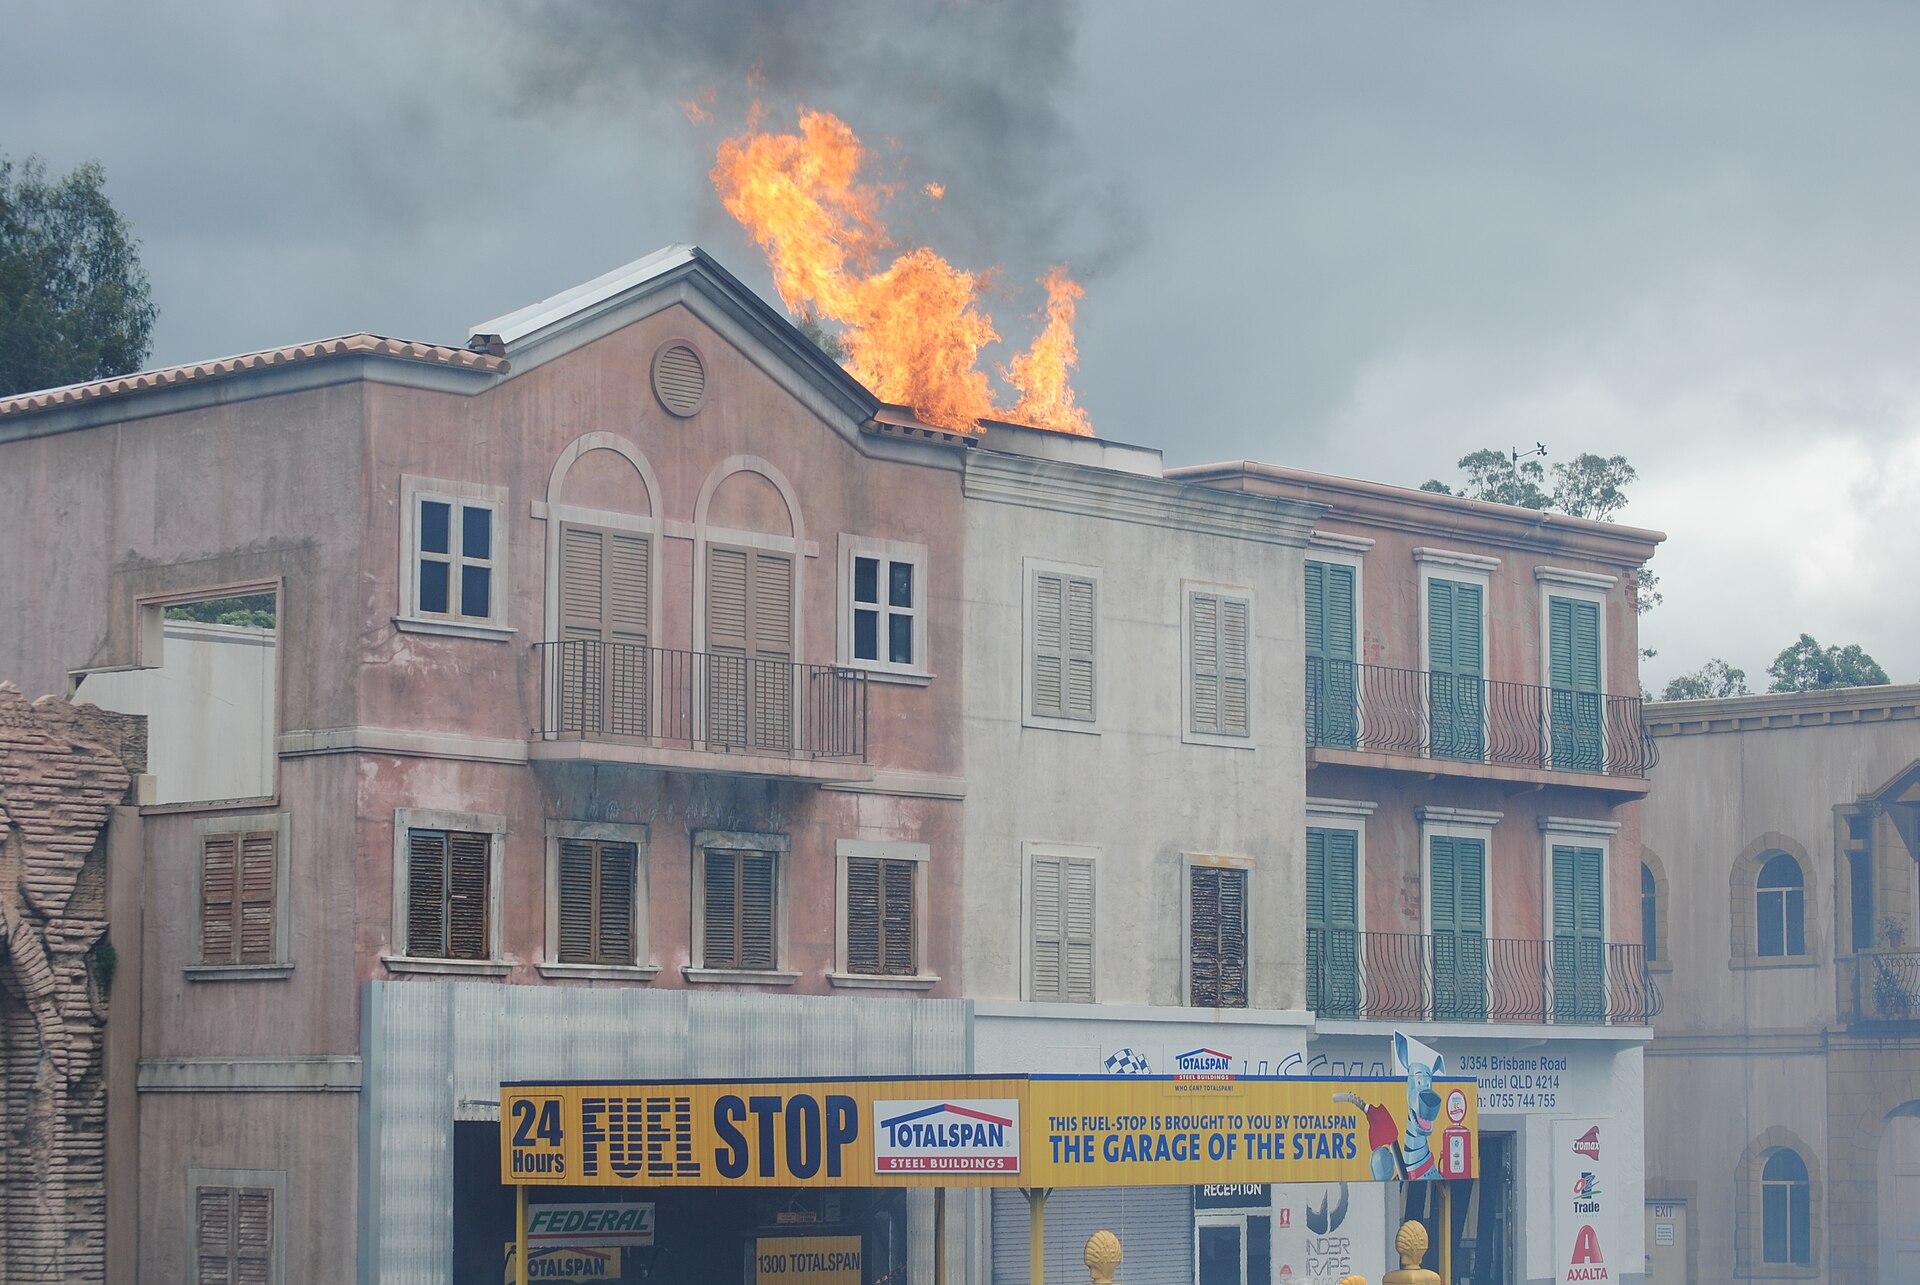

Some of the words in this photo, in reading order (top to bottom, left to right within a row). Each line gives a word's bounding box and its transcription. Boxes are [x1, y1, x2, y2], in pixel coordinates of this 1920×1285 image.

[1177, 1056, 1229, 1070] TOTALSPAN
[1460, 1056, 1488, 1070] 3/354
[1491, 1056, 1537, 1071] Brisbane
[1540, 1056, 1567, 1071] Road
[1478, 1075, 1507, 1089] undel
[1510, 1075, 1533, 1090] QLD
[1535, 1075, 1560, 1089] 4214
[1477, 1094, 1486, 1107] h:
[1490, 1094, 1514, 1107] 0755
[1517, 1094, 1535, 1107] 744
[1538, 1094, 1556, 1107] 755
[511, 1099, 564, 1147] 24
[1049, 1116, 1078, 1131] THIS
[1082, 1115, 1147, 1131] FUEL-STOP
[1150, 1115, 1161, 1130] IS
[1165, 1115, 1225, 1130] BROUGHT
[1227, 1115, 1243, 1129] TO
[1246, 1115, 1272, 1129] YOU
[1275, 1115, 1290, 1129] BY
[1293, 1115, 1356, 1129] TOTALSPAN
[581, 1097, 701, 1178] FUEL
[713, 1094, 859, 1179] STOP
[882, 1121, 1004, 1148] TOTALSPAN
[1049, 1135, 1095, 1163] THE
[1103, 1133, 1200, 1163] GARAGE
[1208, 1132, 1237, 1161] OF
[1244, 1133, 1285, 1160] THE
[1292, 1132, 1357, 1160] STARS
[1572, 1140, 1600, 1151] Cromax
[512, 1149, 565, 1173] Hours
[890, 1158, 926, 1169] STEEL
[930, 1158, 1005, 1169] BUILDINGS
[1573, 1201, 1600, 1213] Trade
[1655, 1205, 1674, 1217] EXIT
[528, 1209, 650, 1232] FEDERAL
[528, 1258, 605, 1278] OTALSPAN
[758, 1255, 787, 1273] 1300
[789, 1252, 860, 1272] TOTALSPAN
[1567, 1267, 1608, 1281] AXALTA
